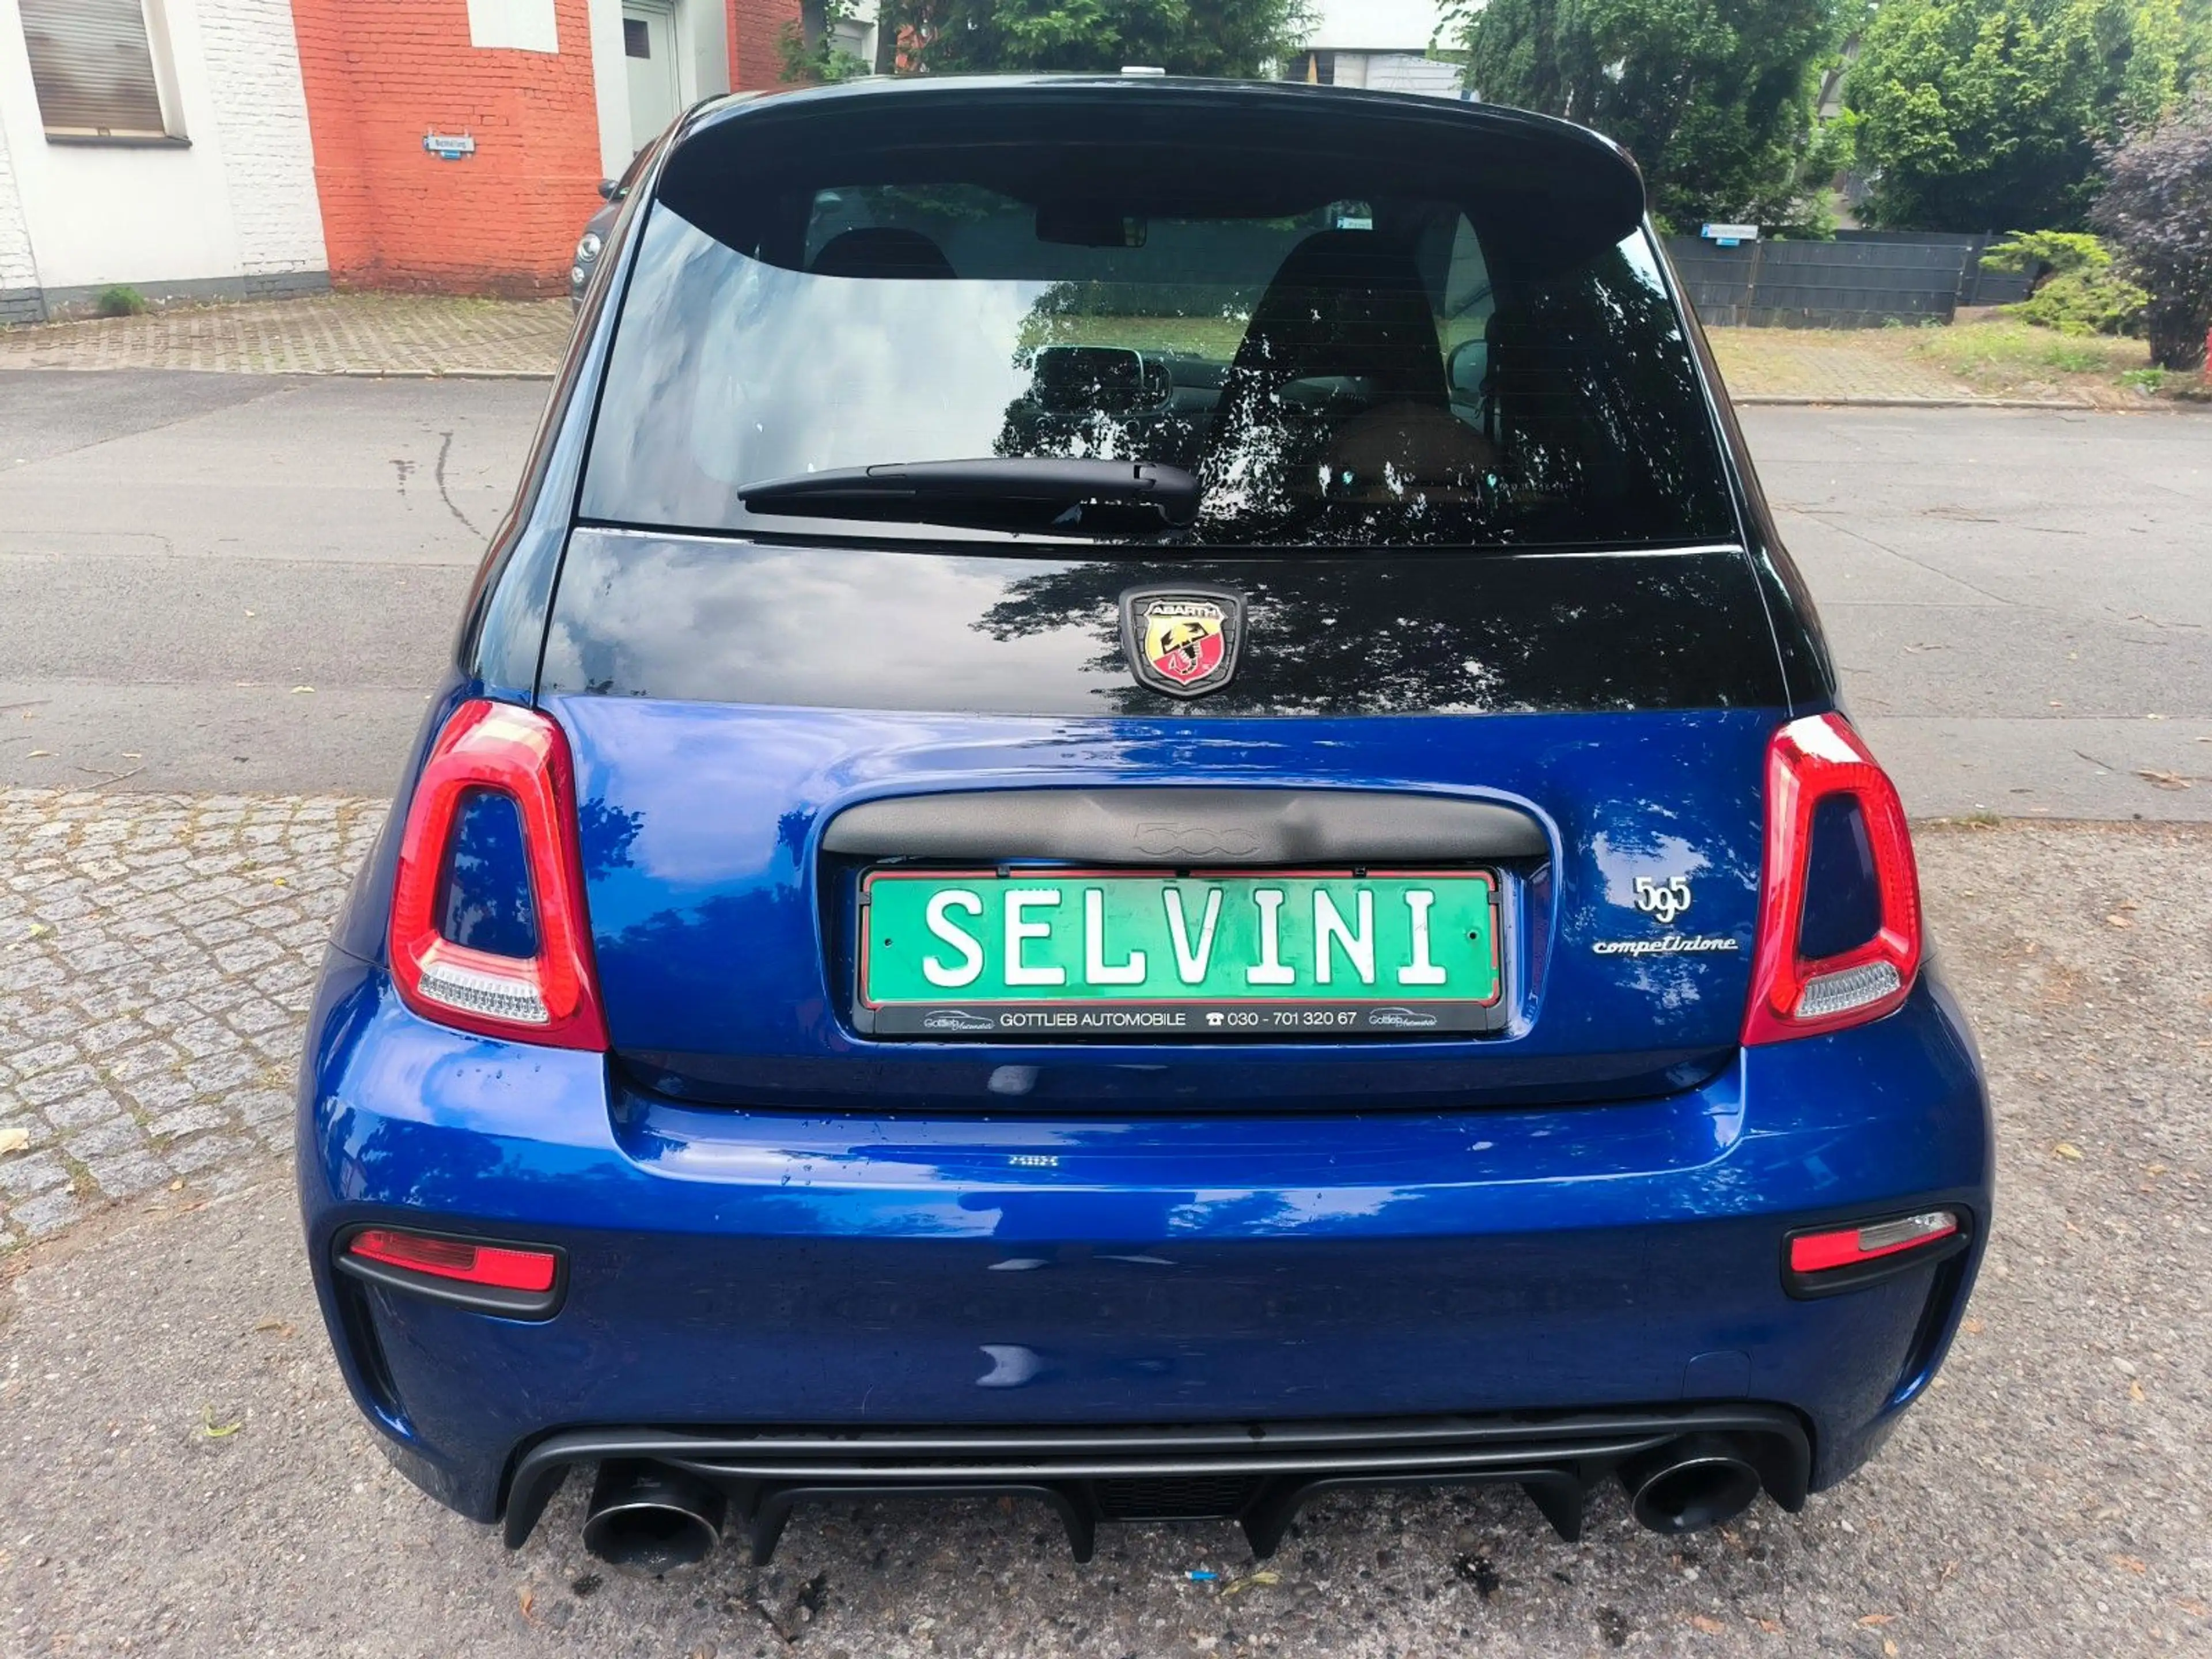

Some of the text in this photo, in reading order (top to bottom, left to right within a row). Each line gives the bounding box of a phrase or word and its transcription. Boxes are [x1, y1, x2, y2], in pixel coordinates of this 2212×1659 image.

[1152, 605, 1218, 616] ABARTH
[1634, 876, 1692, 923] 595
[923, 889, 1447, 987] SELVINI
[1592, 934, 1739, 957] competizione
[1000, 1013, 1078, 1027] GOTTLIEB
[1081, 1013, 1187, 1027] AUTOMOBILE
[1228, 1012, 1259, 1026] 030
[1273, 1012, 1298, 1026] 701
[1303, 1012, 1334, 1026] 320
[1338, 1012, 1358, 1026] 67
